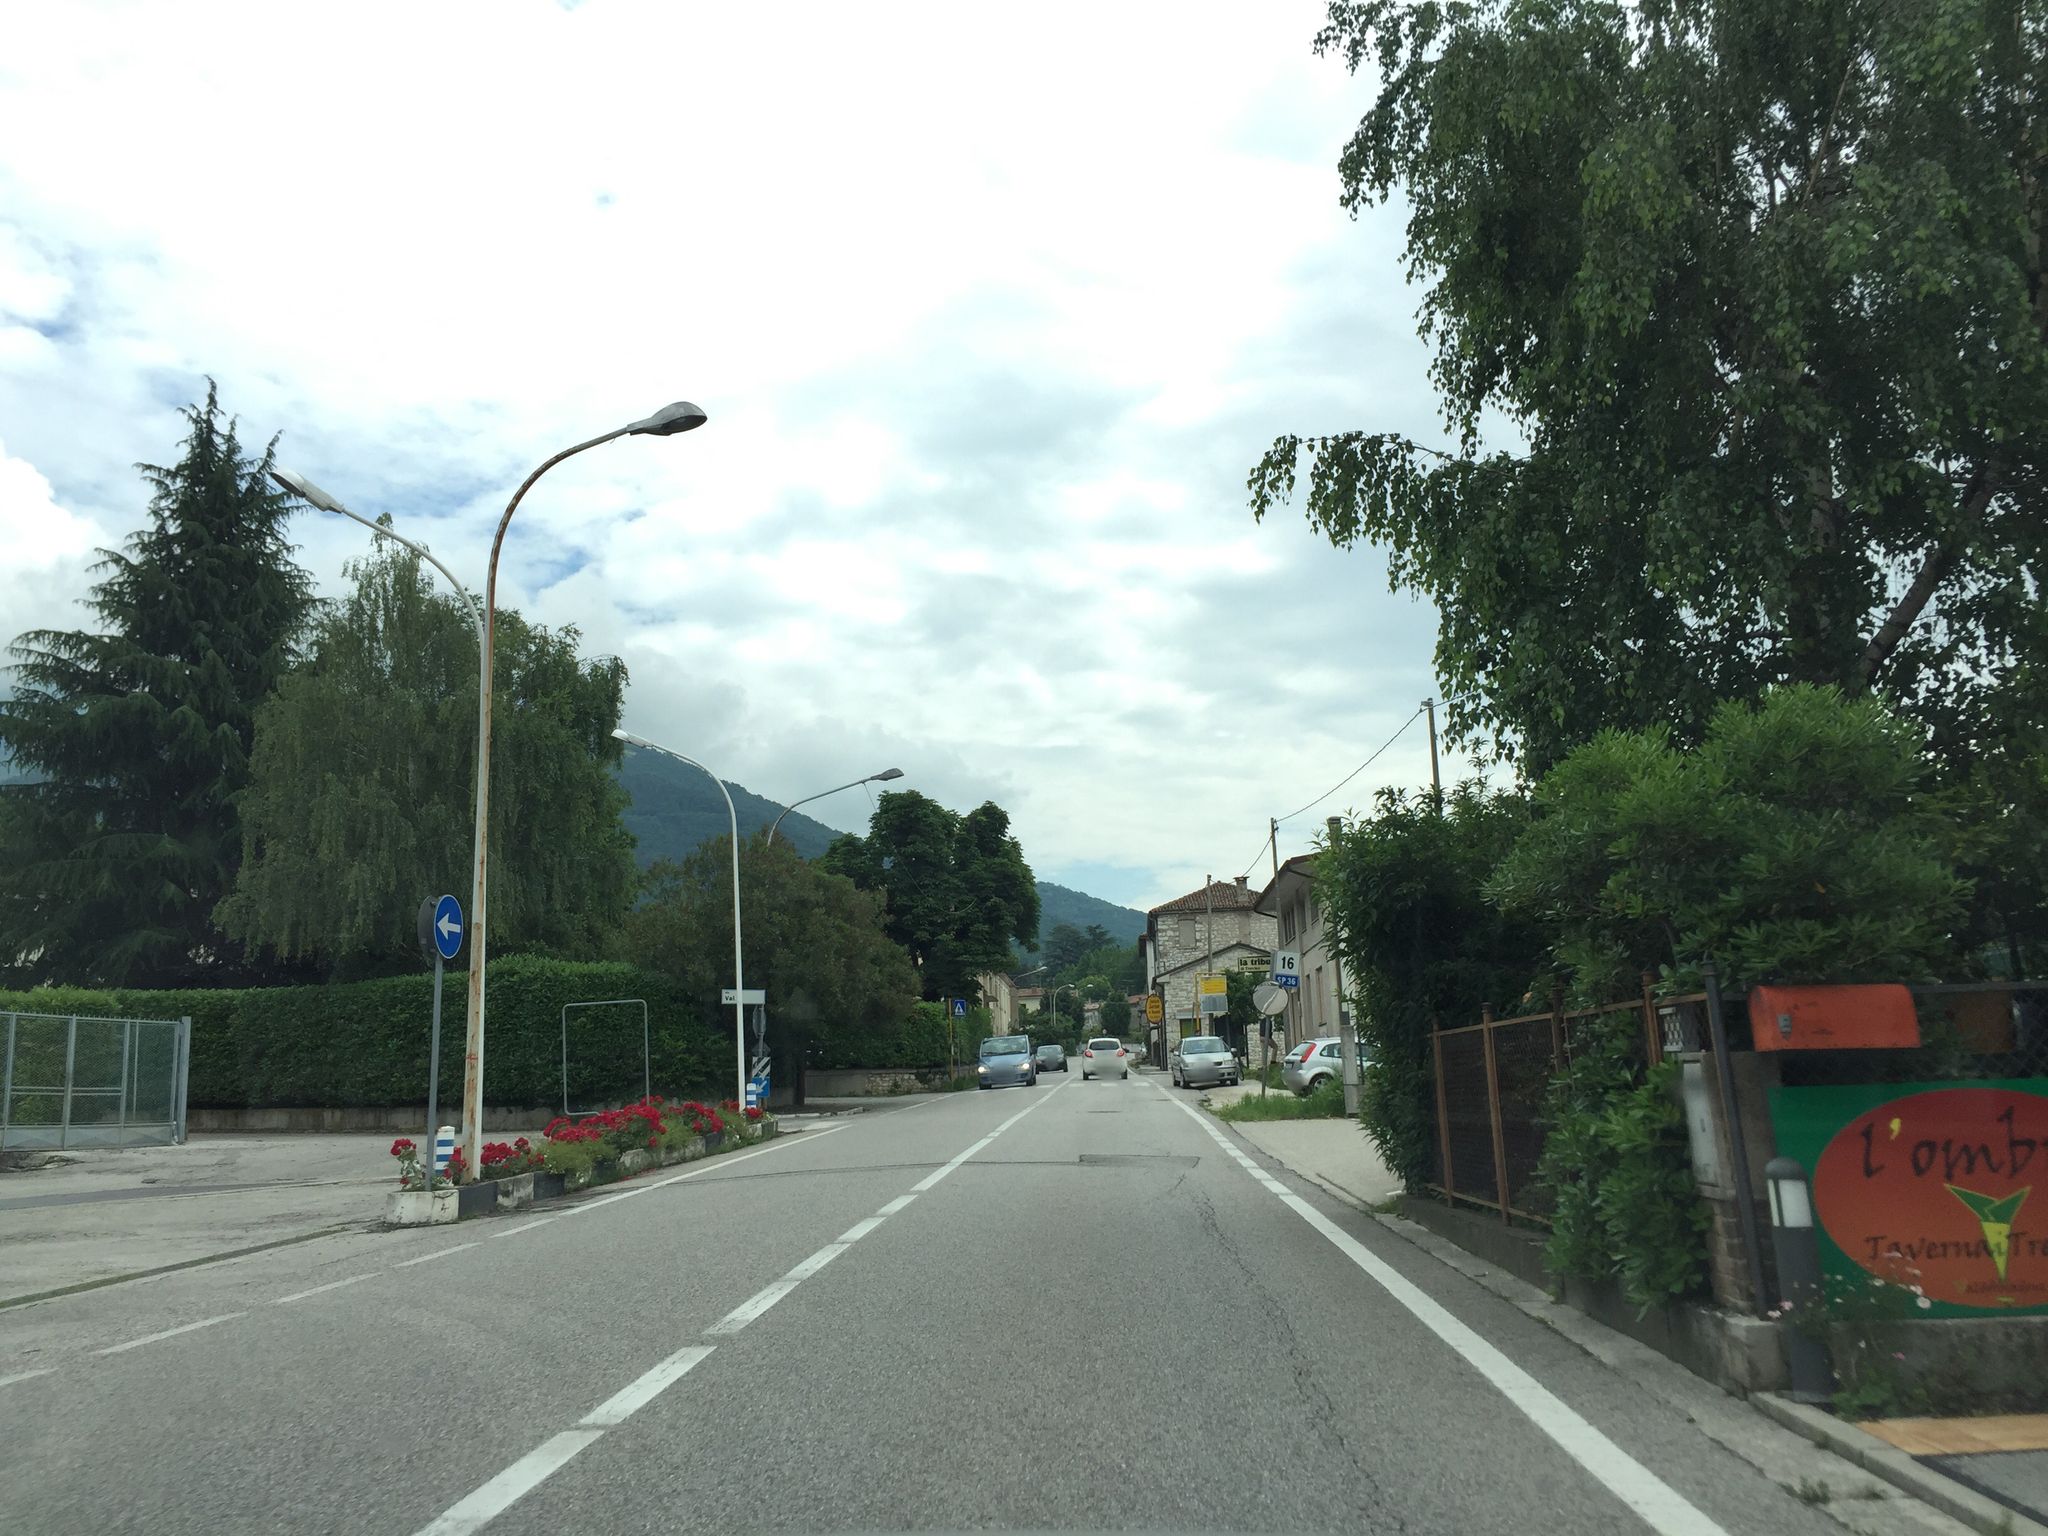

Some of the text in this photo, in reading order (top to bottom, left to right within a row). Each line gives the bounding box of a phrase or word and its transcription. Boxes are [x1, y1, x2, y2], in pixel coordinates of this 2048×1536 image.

[1281, 955, 1295, 970] 16
[1286, 977, 1296, 985] 36
[1861, 1105, 2048, 1182] l'omb
